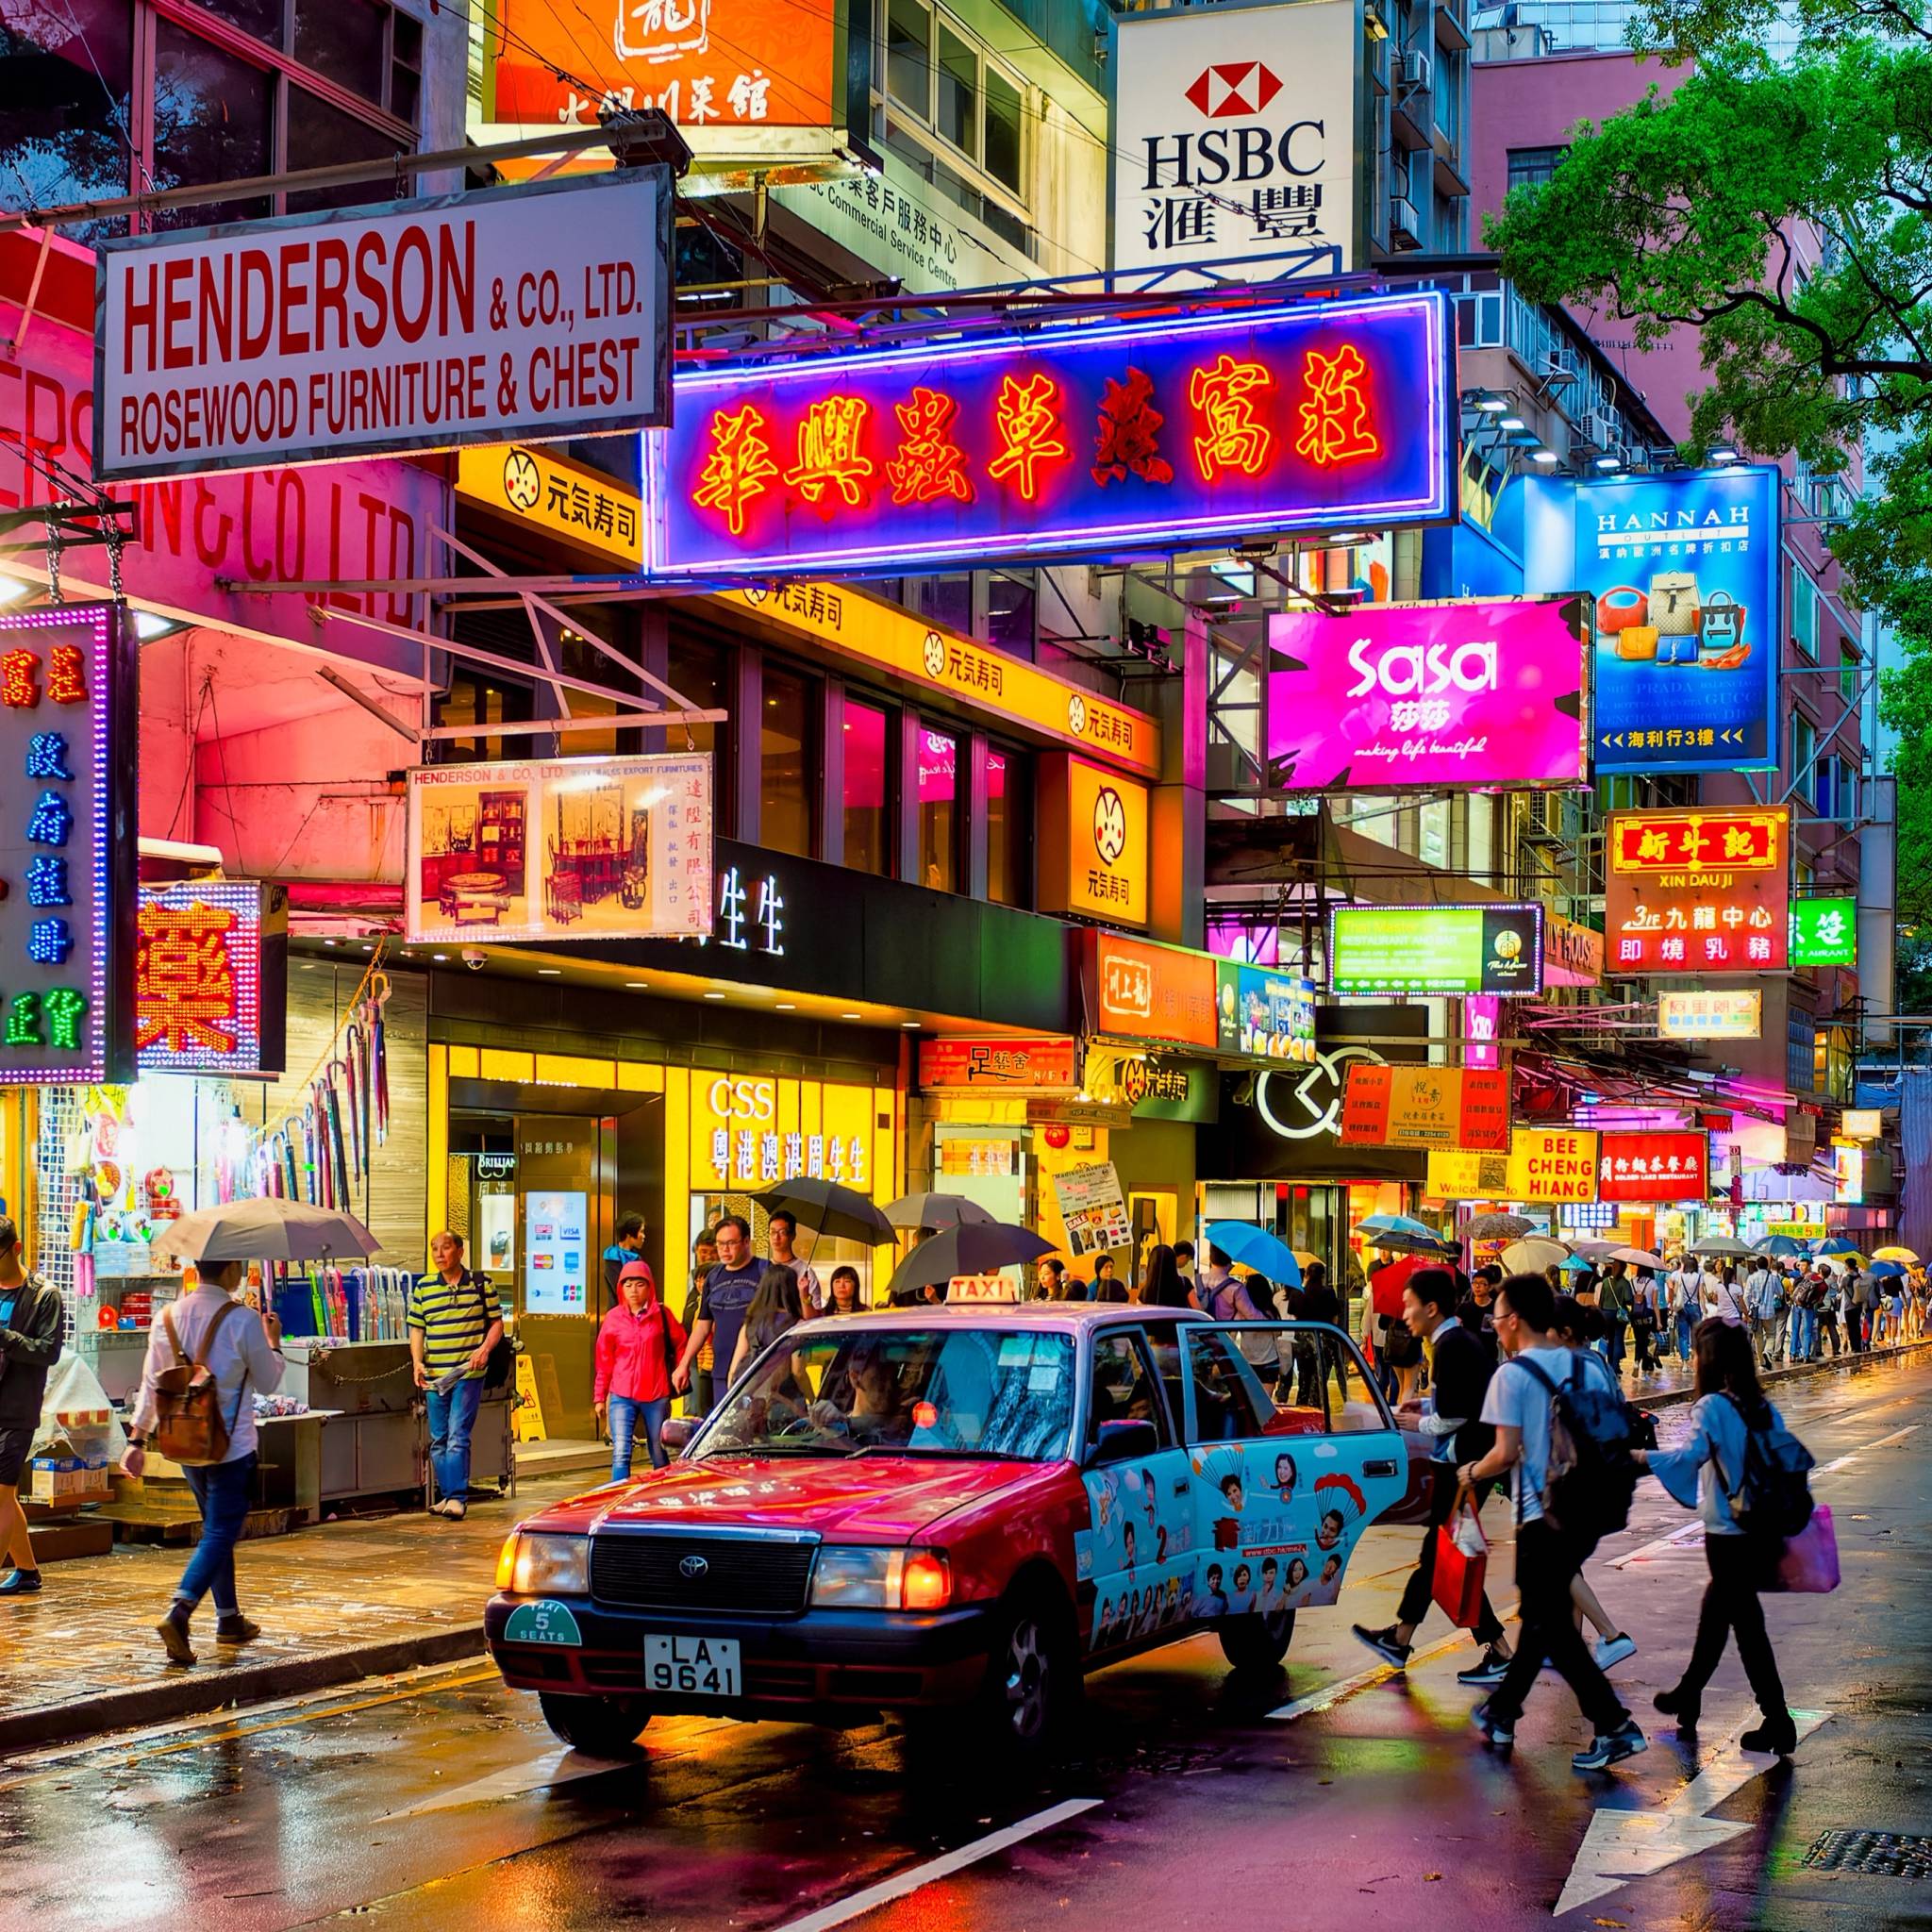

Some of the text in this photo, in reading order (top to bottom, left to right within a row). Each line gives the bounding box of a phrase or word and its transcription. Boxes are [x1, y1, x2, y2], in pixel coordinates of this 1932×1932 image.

[1141, 119, 1325, 190] HSBC
[842, 174, 958, 265] 業客戶服務中心
[827, 185, 887, 242] Commercial
[890, 229, 925, 269] Service
[927, 256, 958, 291] Centre
[123, 220, 643, 375] HENDERSON & CO., LTD.
[120, 337, 641, 458] ROSEWOOD FURNITURE & CHEST
[547, 475, 636, 547] 元気寿司
[1597, 506, 1750, 531] HANNAH
[1624, 529, 1722, 541] OUTLET
[948, 647, 1004, 697] 元気寿司
[1705, 691, 1763, 705] GUCCI
[1390, 700, 1451, 732] 莎莎
[1087, 708, 1133, 752] 元気寿司
[1354, 736, 1488, 763] making life beautiful
[414, 767, 491, 785] HENDERSON
[496, 770, 507, 781] &
[624, 765, 654, 775] EXPORT
[657, 764, 703, 774] FURNITURES
[1637, 826, 1755, 860] 新斗記
[668, 879, 679, 904] 出口
[1087, 870, 1130, 906] 元気寿司
[1659, 874, 1733, 889] XIN DAU JI
[703, 867, 786, 957] 生生
[1665, 906, 1773, 930] 九龍中心
[1619, 937, 1773, 960] 即燒乳豬
[710, 1078, 774, 1121] CSS
[1543, 1138, 1577, 1155] BEE
[1055, 1162, 1111, 1179] Madison Avenue
[1528, 1158, 1592, 1175] CHENG
[1507, 1185, 1517, 1196] to
[1529, 1179, 1589, 1197] HIANG
[562, 1227, 580, 1236] VISA
[1067, 1213, 1088, 1230] SALE
[953, 1280, 1004, 1298] TAXI
[530, 1601, 561, 1614] TAXI
[535, 1612, 549, 1630] 5
[520, 1629, 565, 1641] SEATS
[671, 1637, 712, 1665] LA
[654, 1663, 733, 1694] 9641
